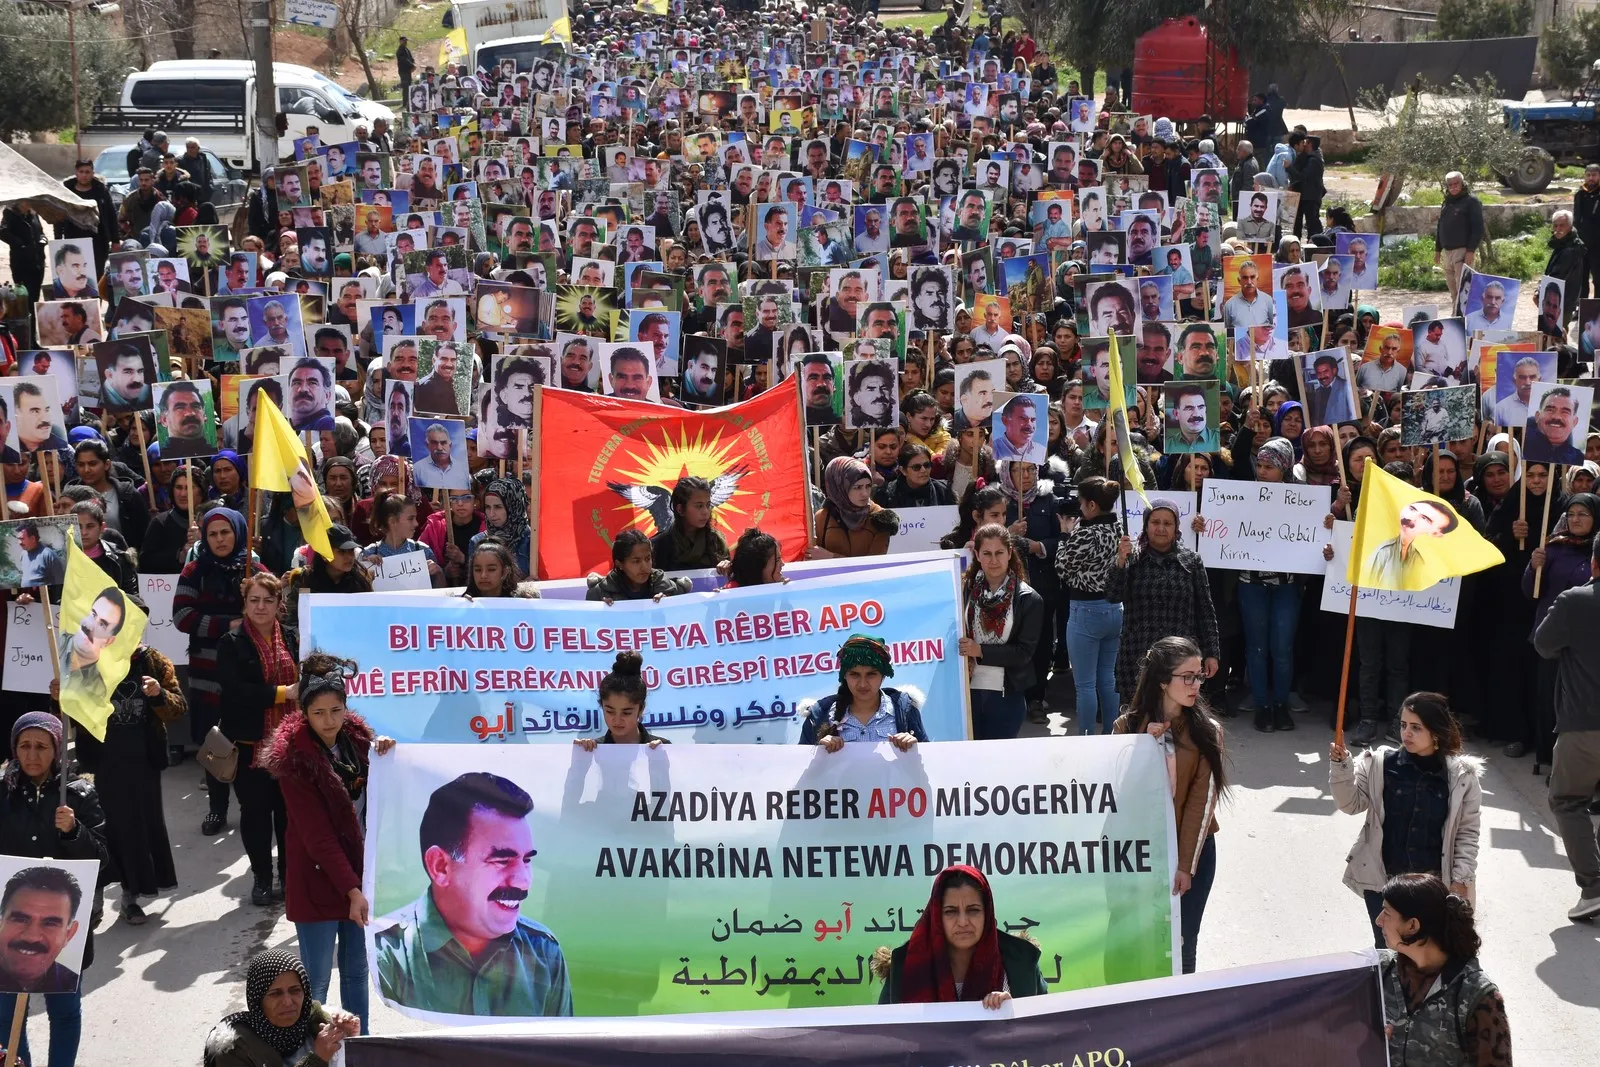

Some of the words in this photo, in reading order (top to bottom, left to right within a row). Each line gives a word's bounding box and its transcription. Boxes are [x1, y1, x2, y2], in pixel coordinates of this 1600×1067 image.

[588, 434, 623, 483] TEVGERA
[1208, 486, 1245, 506] Jiyana
[1258, 486, 1273, 502] Bê
[1284, 489, 1317, 507] Rêber
[900, 517, 926, 536] iyarê
[1237, 521, 1272, 543] Nayê
[13, 605, 32, 626] Bê
[389, 624, 419, 649] BI
[427, 625, 507, 650] FIKIR
[513, 622, 534, 651] Û
[543, 623, 708, 651] FELSEFEYA
[714, 608, 812, 644] RÊBER
[819, 599, 884, 631] APO
[11, 646, 43, 667] Jiyan
[391, 666, 467, 694] EFRÎN
[474, 666, 608, 690] SERÊKANI
[641, 665, 659, 688] Û
[666, 655, 767, 687] GIRÊSPÎ
[773, 651, 841, 677] RIZG
[885, 638, 944, 664] IKIN
[469, 702, 515, 740] آبو
[522, 706, 600, 732] القائد
[733, 694, 797, 726] بفكر
[631, 786, 757, 822] AZADÎYA
[766, 788, 860, 820] REBER
[867, 787, 928, 819] APO
[935, 779, 1118, 817] MÎSOGERÎYA
[595, 842, 773, 878] AVAKÎRÎNA
[782, 844, 915, 878] NETEWA
[923, 835, 1152, 877] DEMOKRATÎKE
[711, 907, 803, 942] ضمان
[813, 901, 854, 942] آبو
[671, 954, 873, 996] الديمقراطية
